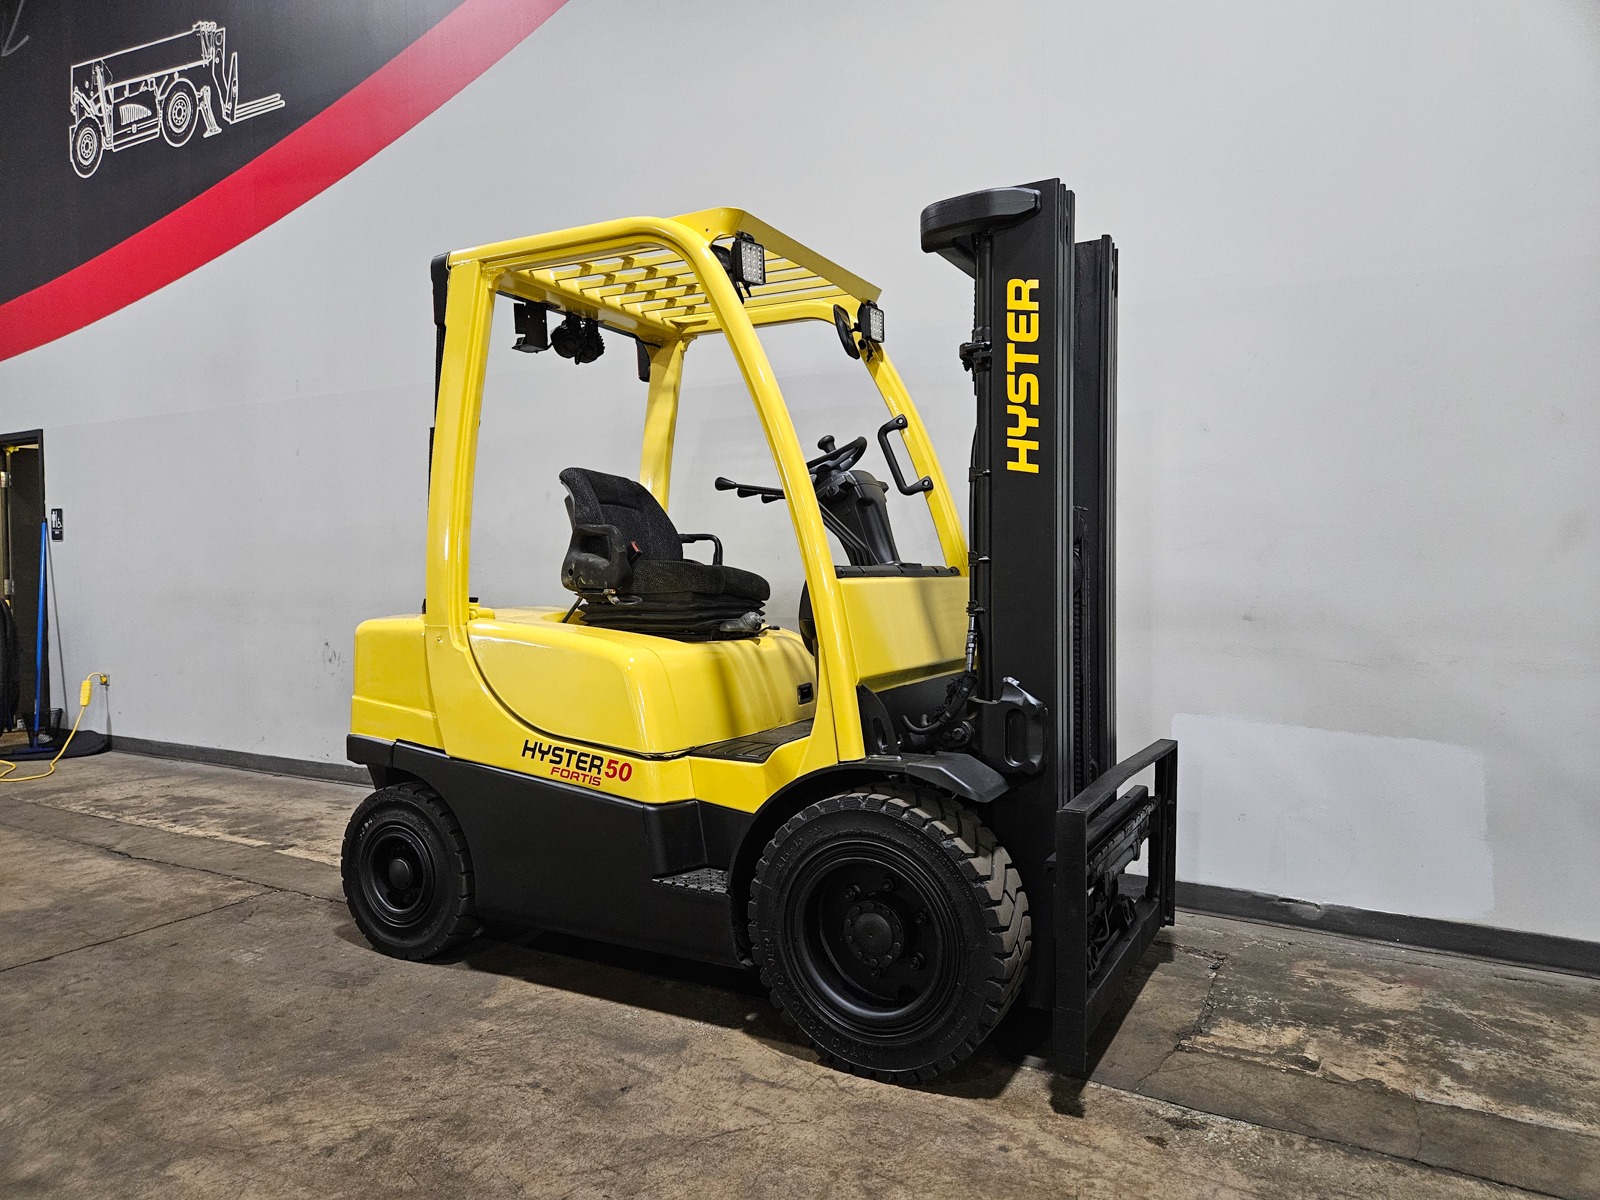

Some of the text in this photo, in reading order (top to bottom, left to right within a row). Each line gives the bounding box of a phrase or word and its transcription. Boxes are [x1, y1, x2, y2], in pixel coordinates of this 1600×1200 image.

[1007, 278, 1040, 474] HYSTER
[521, 739, 633, 783] HYSTER 50
[550, 766, 602, 787] FORTIS
